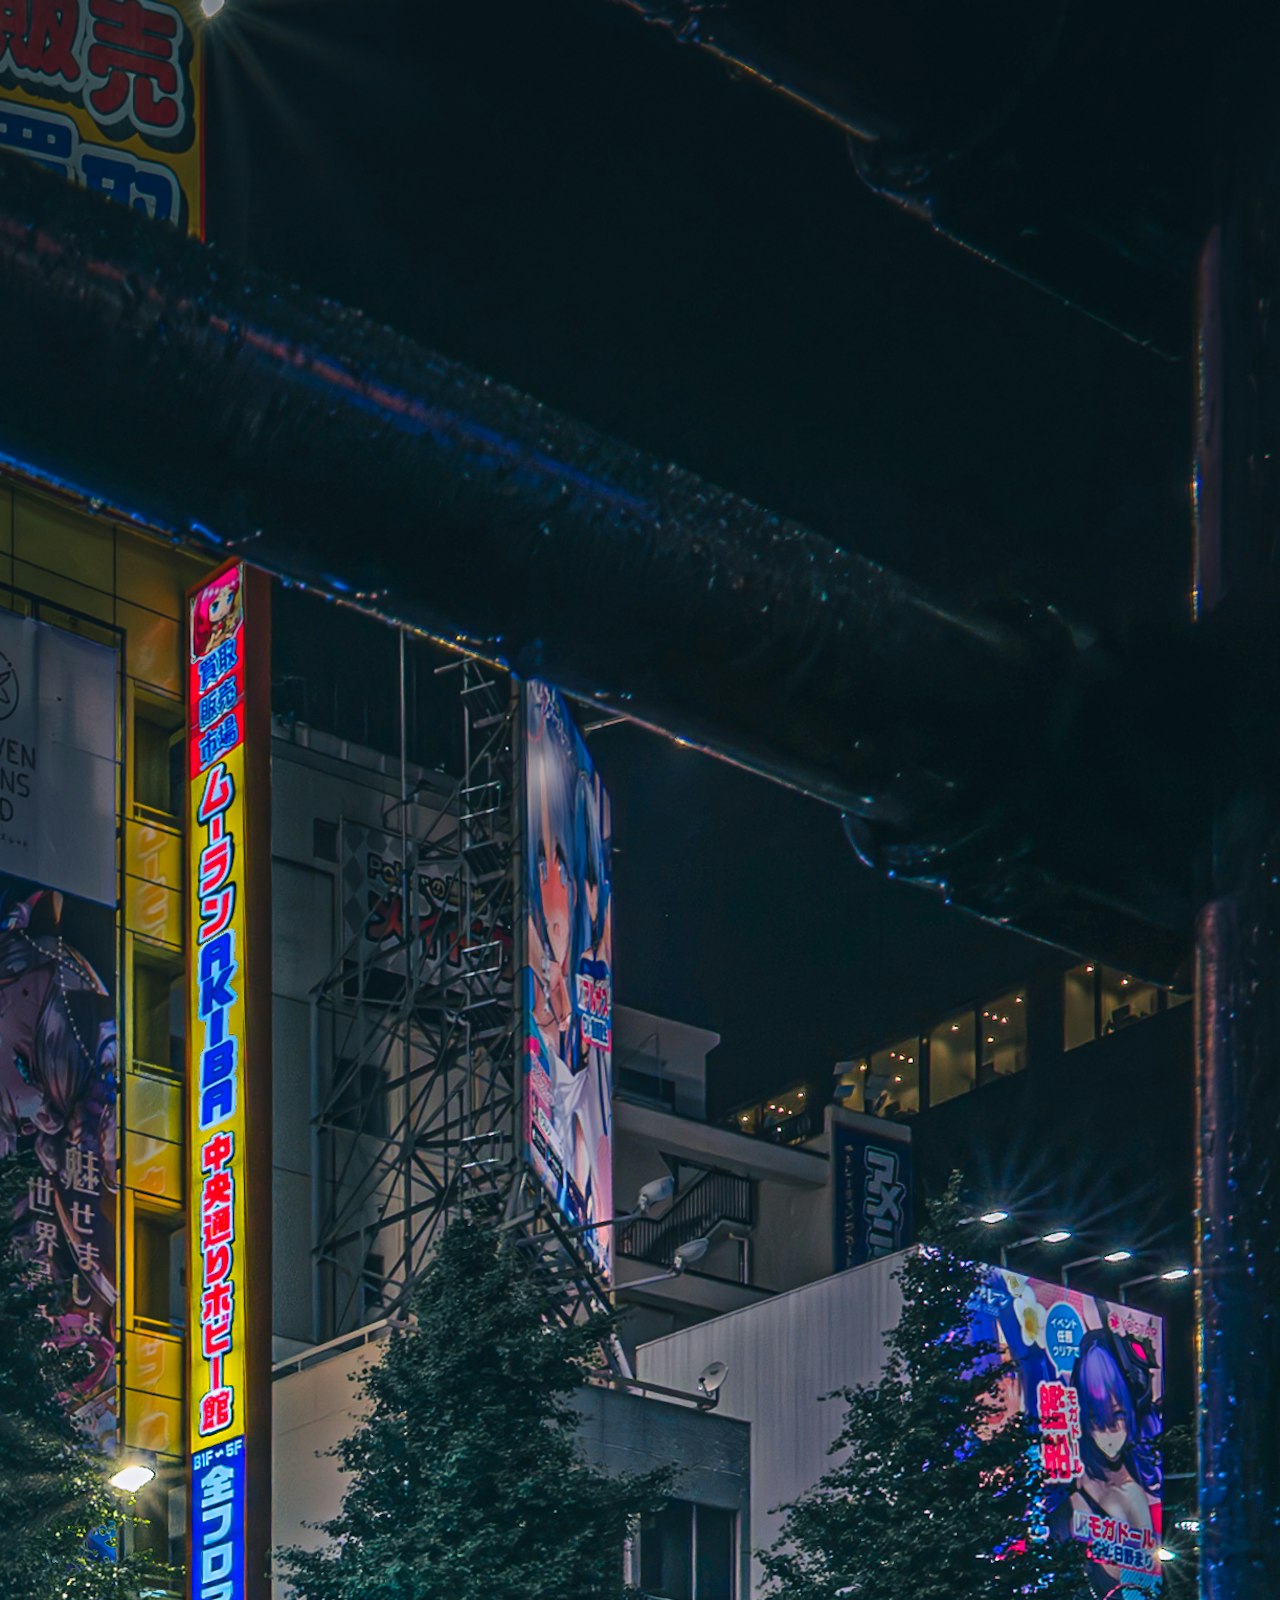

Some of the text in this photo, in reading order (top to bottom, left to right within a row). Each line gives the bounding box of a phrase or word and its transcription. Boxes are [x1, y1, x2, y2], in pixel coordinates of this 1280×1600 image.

[201, 1131, 235, 1437] 中央通りホビー館
[1088, 1515, 1156, 1549] モガドール
